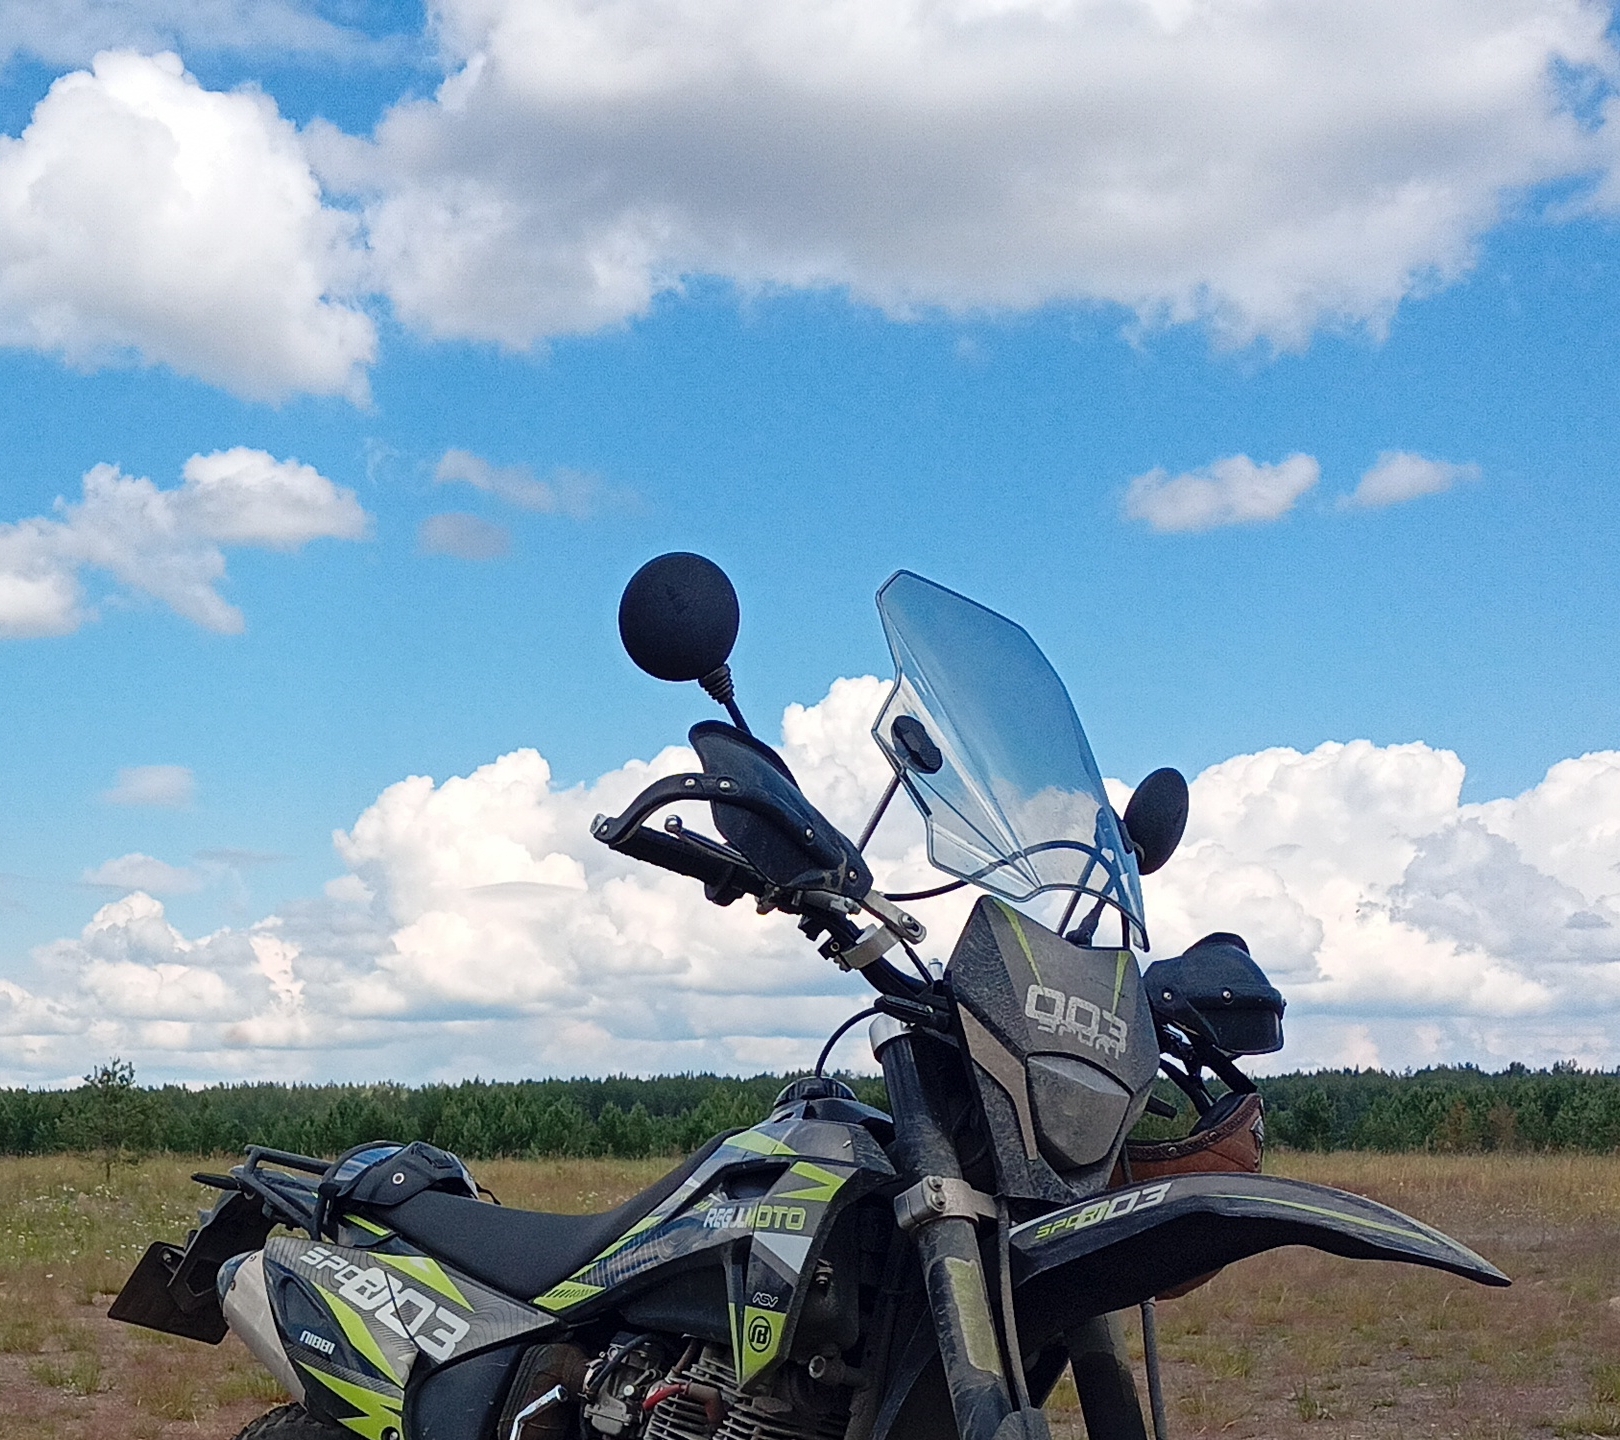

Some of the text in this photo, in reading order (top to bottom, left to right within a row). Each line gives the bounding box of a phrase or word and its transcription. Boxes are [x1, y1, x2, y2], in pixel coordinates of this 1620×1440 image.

[1025, 984, 1127, 1053] 003
[703, 1203, 806, 1230] REGULMOTO
[1074, 1183, 1172, 1230] 003
[299, 1247, 396, 1301] SPOR
[338, 1267, 471, 1361] 003
[299, 1330, 336, 1355] NIBBI
